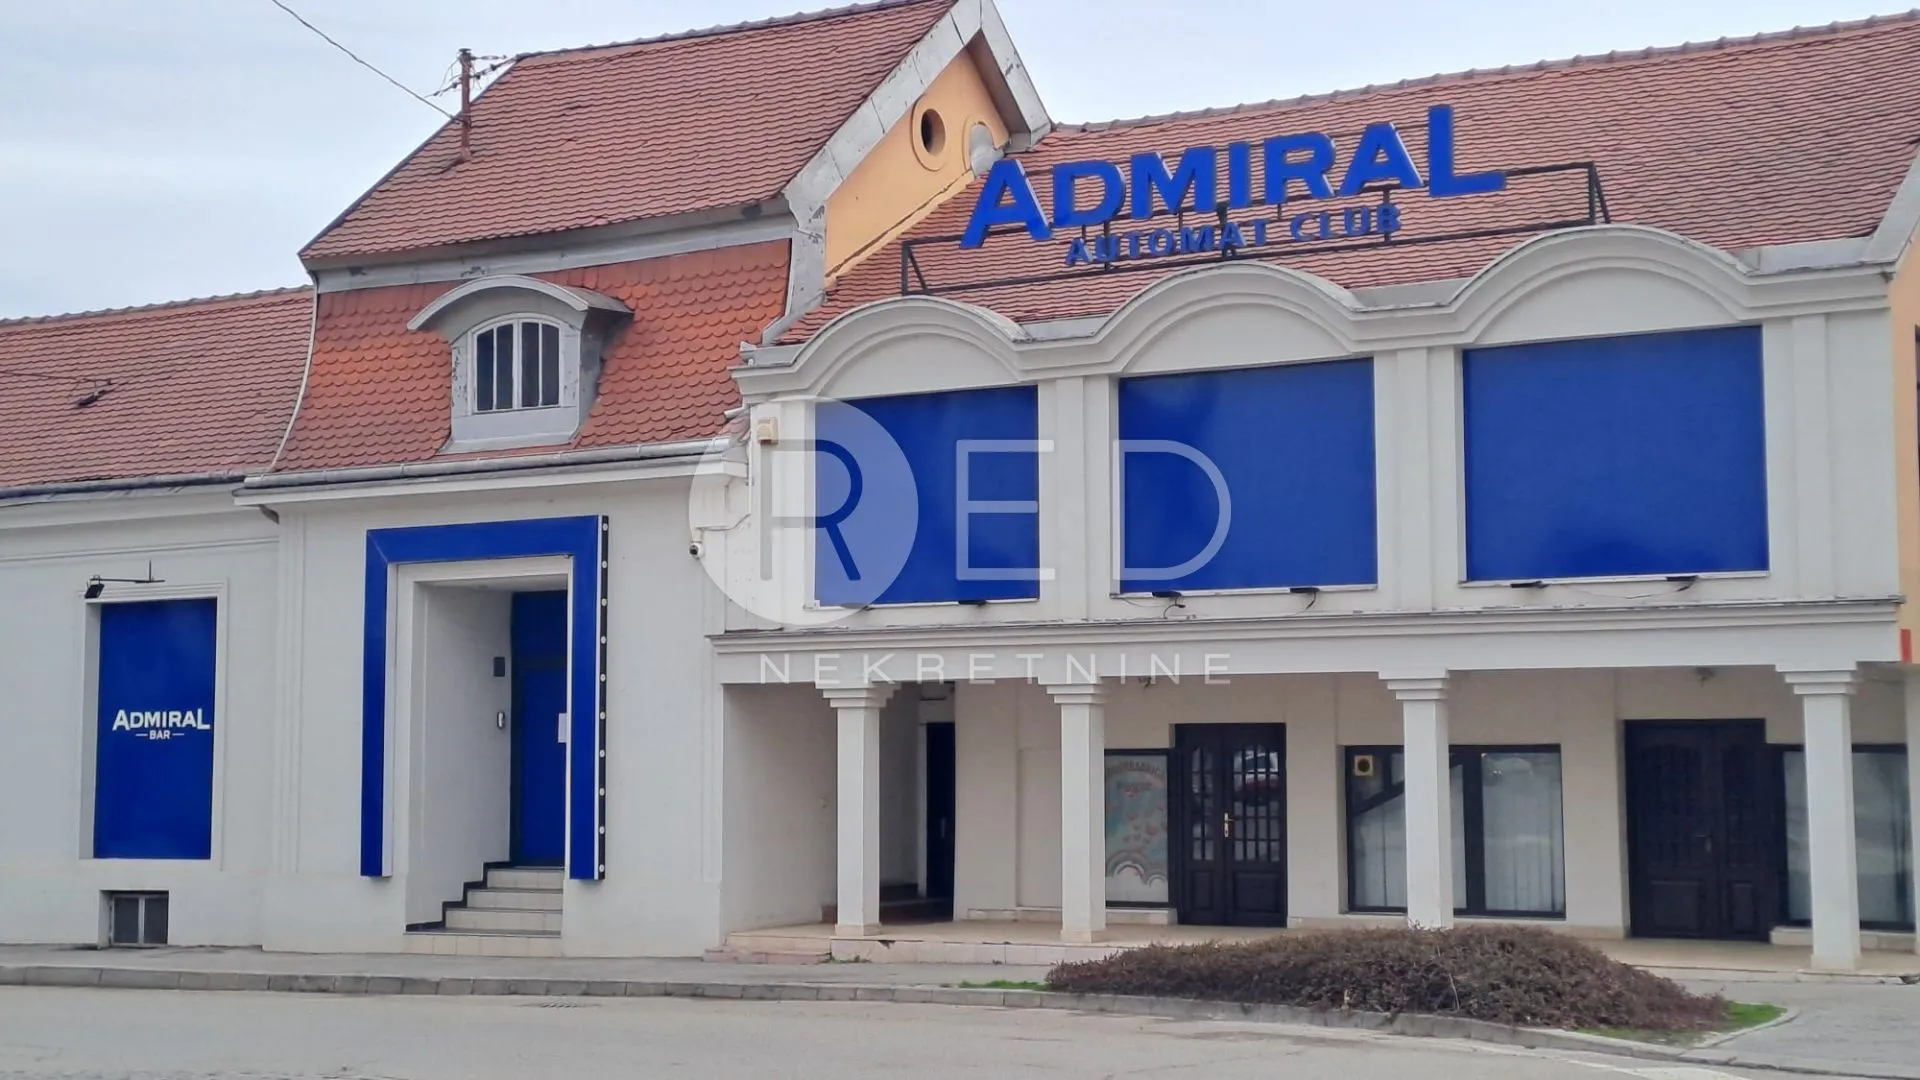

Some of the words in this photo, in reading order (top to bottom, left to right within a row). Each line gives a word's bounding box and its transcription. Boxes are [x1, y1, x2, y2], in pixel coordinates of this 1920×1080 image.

[960, 104, 1506, 249] ADMIRAL
[1066, 219, 1268, 266] AUTOMAT
[1290, 203, 1402, 241] CLUB
[112, 708, 211, 731] ADMIRAL
[149, 730, 171, 740] BAR
